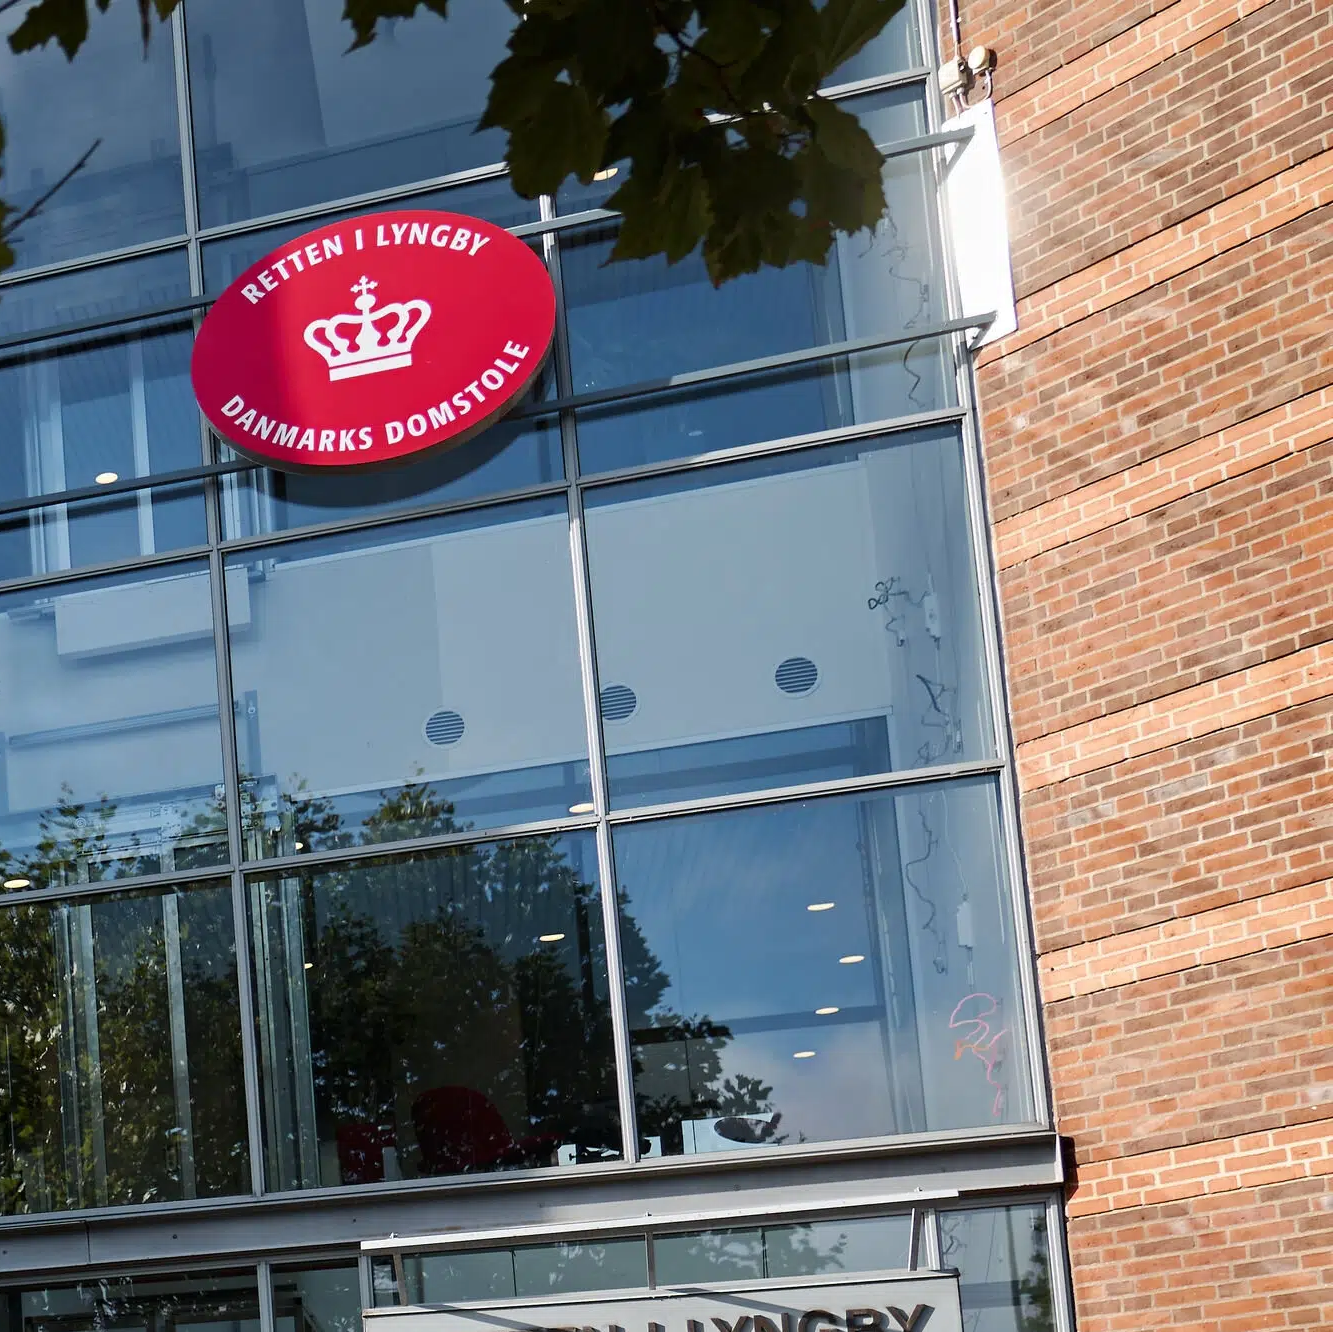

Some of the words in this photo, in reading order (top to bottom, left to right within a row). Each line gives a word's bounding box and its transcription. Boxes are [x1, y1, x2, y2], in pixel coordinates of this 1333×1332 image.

[241, 233, 343, 305] RETTEN
[355, 229, 365, 251] I
[376, 222, 491, 257] LYNGBY
[220, 394, 373, 452] DANMARKS
[385, 339, 530, 445] DOMSTOLE
